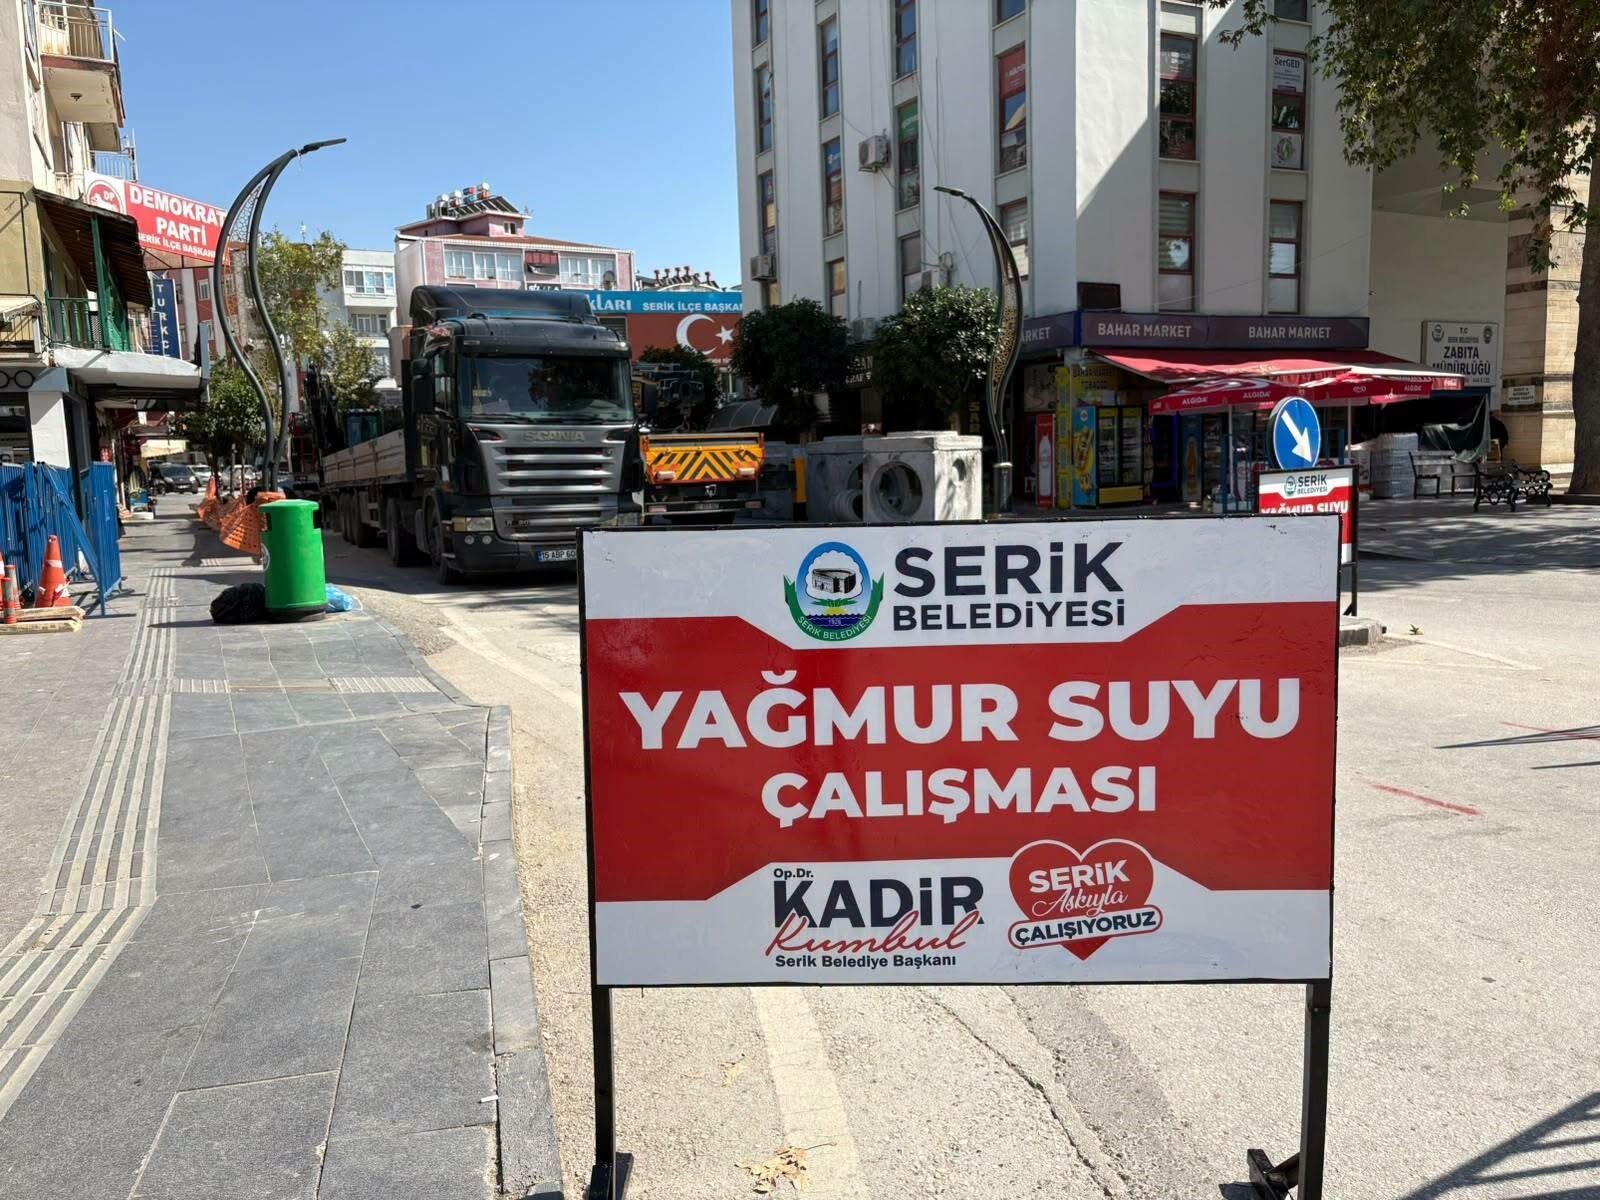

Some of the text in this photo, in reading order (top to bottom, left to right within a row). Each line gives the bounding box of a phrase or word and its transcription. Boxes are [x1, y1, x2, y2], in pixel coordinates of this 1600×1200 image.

[103, 190, 115, 202] DP
[128, 184, 228, 228] DEMOKRAT
[156, 216, 207, 246] PARTİ
[162, 237, 182, 251] İLÇE
[642, 301, 674, 311] SERİK
[678, 301, 702, 313] İLÇE
[704, 303, 743, 313] BAŞKA
[1098, 323, 1193, 338] BAHAR MARKET
[1248, 326, 1332, 339] BAHAR MARKET
[1444, 346, 1480, 360] ZABITA
[1243, 391, 1271, 399] ALGIDA
[523, 430, 585, 442] SCANIA
[618, 669, 1301, 750] YAĞMUR SUYU
[762, 765, 1156, 828] ÇALIŞMASI
[773, 868, 814, 880] Op.Dr.
[765, 910, 980, 957] Kumbul
[1015, 911, 1157, 946] ÇALIŞIYORUZ
[775, 954, 957, 970] Serik Belediye Başkanı
